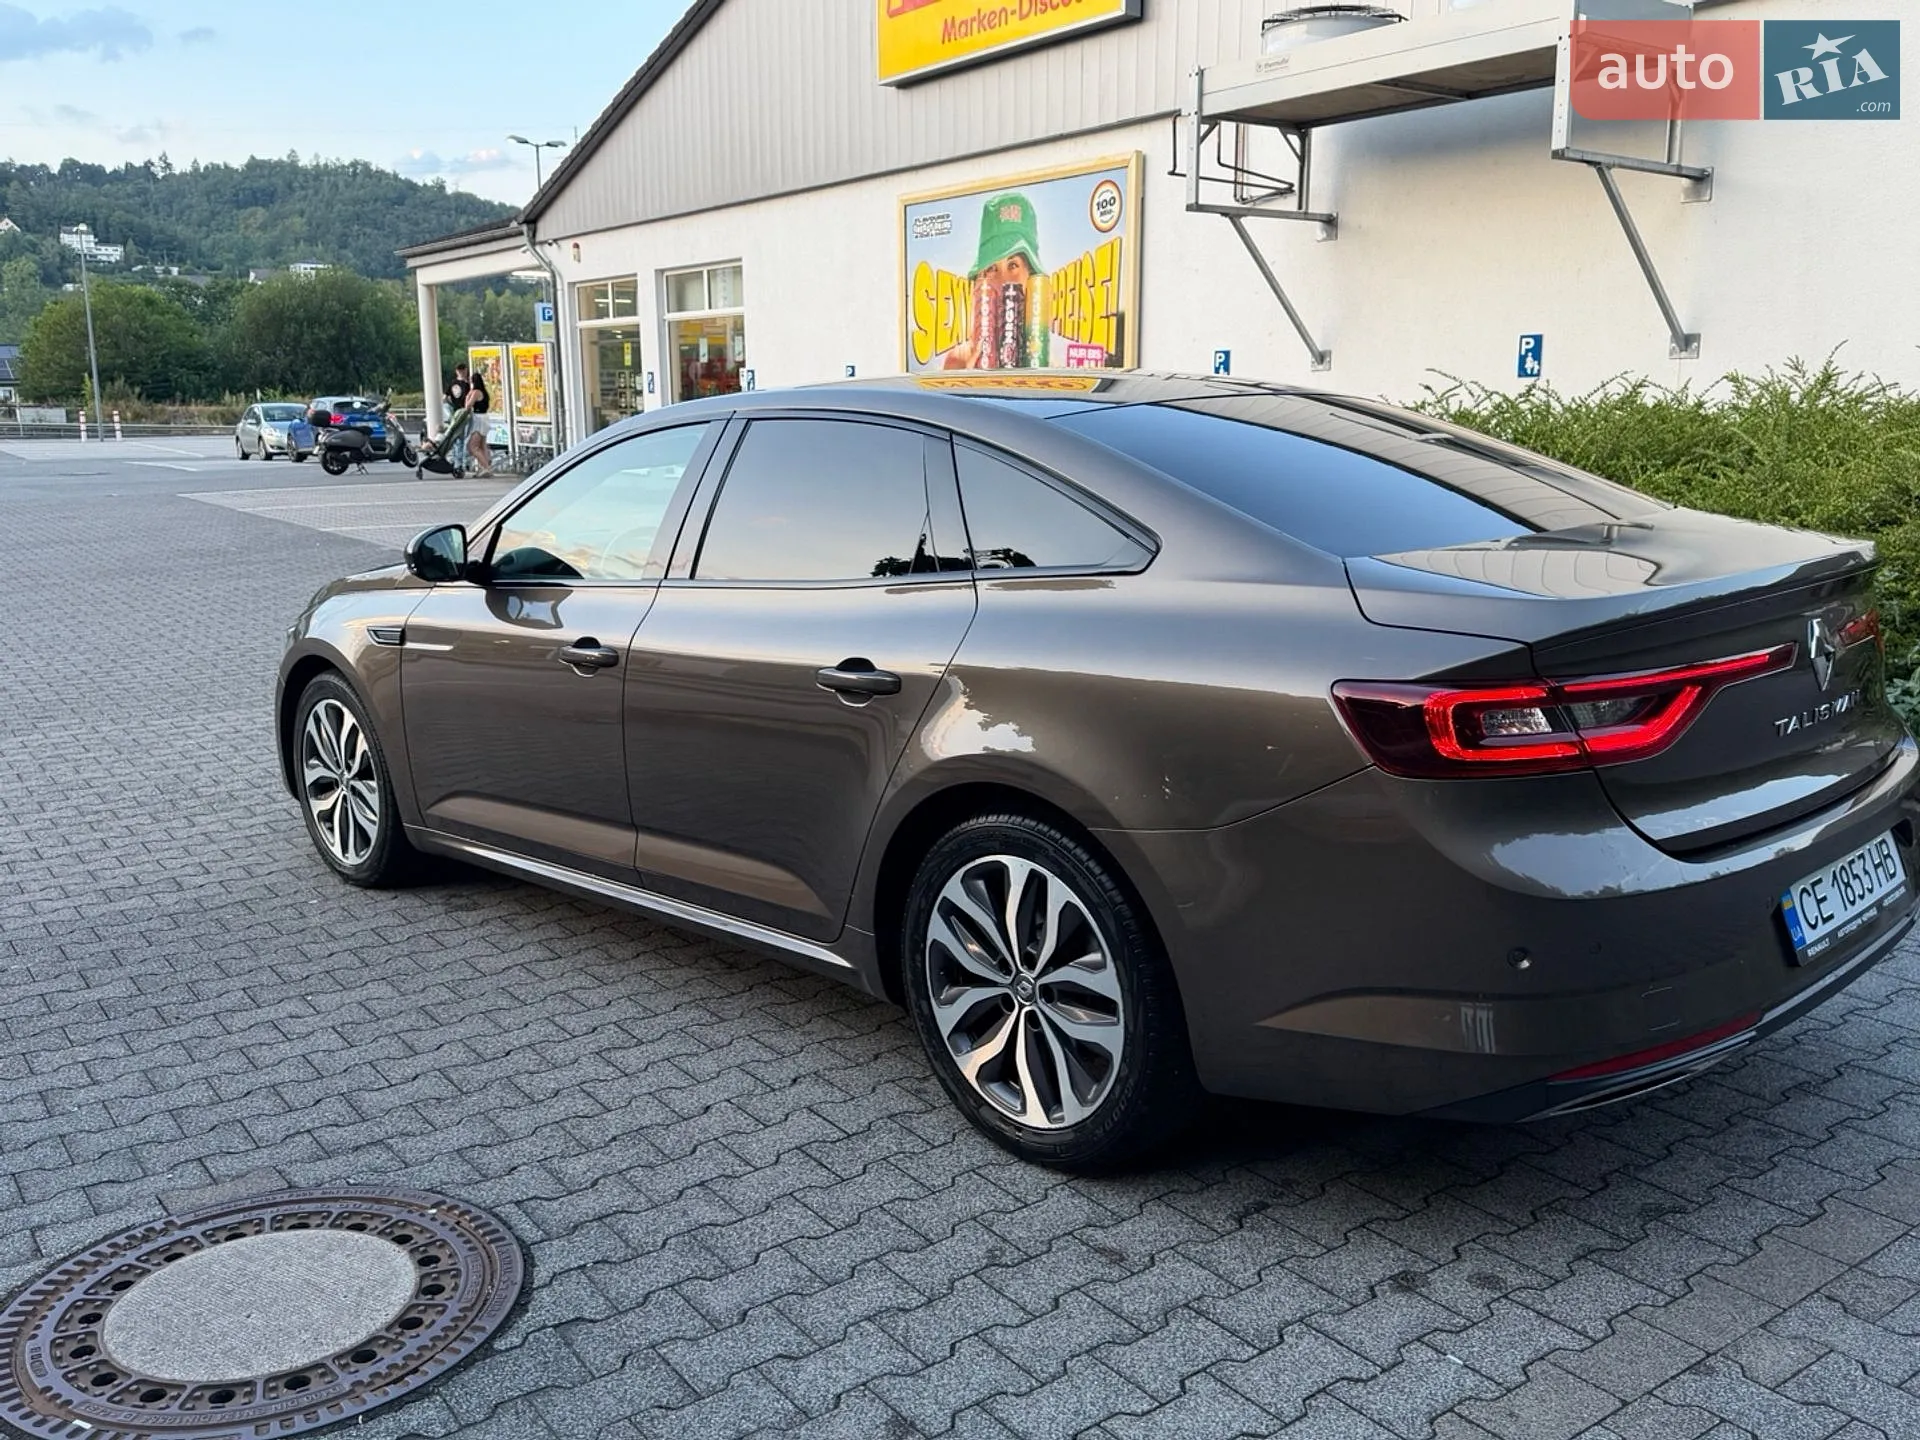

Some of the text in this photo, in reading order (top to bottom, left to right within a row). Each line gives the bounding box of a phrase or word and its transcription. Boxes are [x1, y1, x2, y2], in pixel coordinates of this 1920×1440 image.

[1096, 196, 1116, 211] 100
[1521, 337, 1535, 355] P
[1215, 353, 1226, 367] P
[1799, 877, 1835, 931] CE
[1831, 852, 1874, 912] 1853
[1867, 838, 1897, 889] HB
